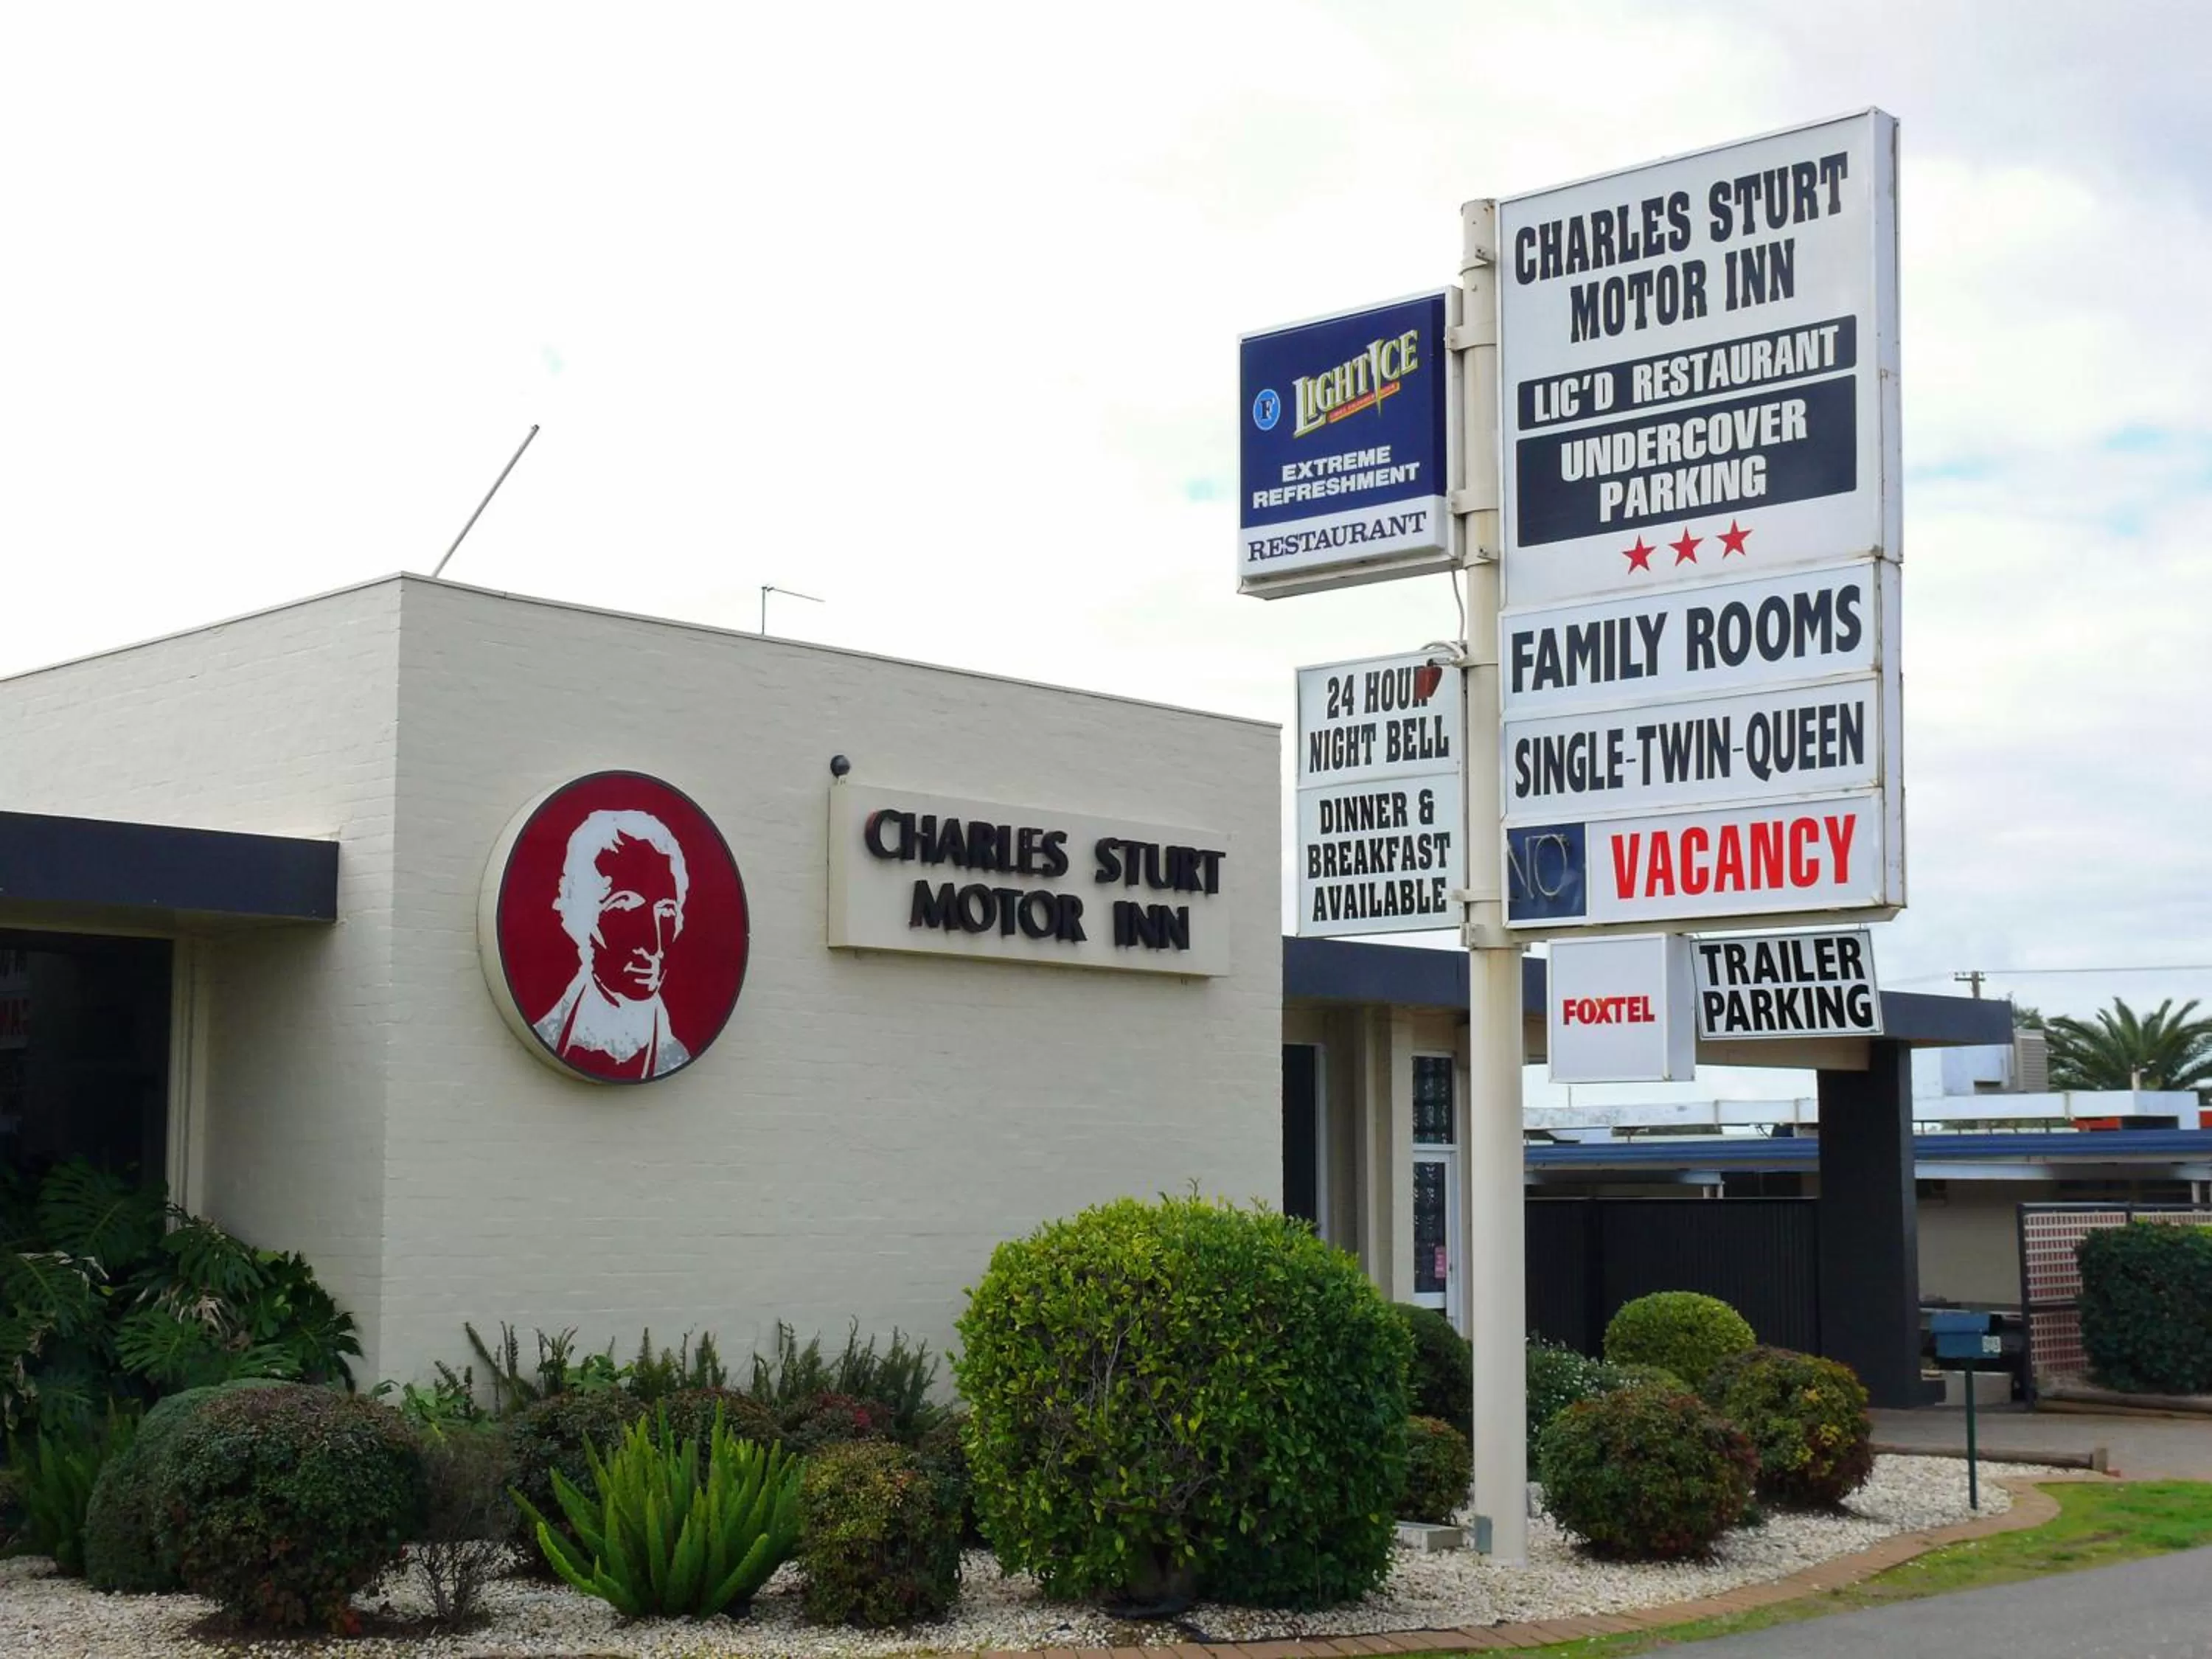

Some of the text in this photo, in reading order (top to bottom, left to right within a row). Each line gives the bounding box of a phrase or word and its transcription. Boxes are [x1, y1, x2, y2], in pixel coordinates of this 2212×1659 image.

[1515, 152, 1848, 285] CHARLES STURT
[1570, 237, 1795, 344] MOTOR INN
[1534, 325, 1840, 422] LIC'D RESTAURANT
[1282, 445, 1391, 482] EXTREME
[1561, 398, 1807, 481] UNDERCOVER
[1253, 462, 1420, 509] REFRESHMENT
[1599, 455, 1767, 523] PARKING
[1248, 511, 1426, 562] RESTAURANT
[1511, 585, 1861, 694] FAMILY ROOMS
[1327, 675, 1354, 719] 24
[1310, 715, 1449, 773] NIGHT BELL
[1319, 789, 1433, 834] DINNER &
[866, 809, 1225, 894] CHARLES STURT
[1307, 832, 1450, 880] BREAKFAST
[1612, 814, 1856, 900] VACANCY
[909, 880, 1189, 950] MOTOR INN
[1312, 877, 1447, 922] AVAILABLE
[1699, 937, 1865, 987] TRAILER
[1563, 995, 1655, 1025] FOXTEL
[1702, 984, 1872, 1033] PARKING
